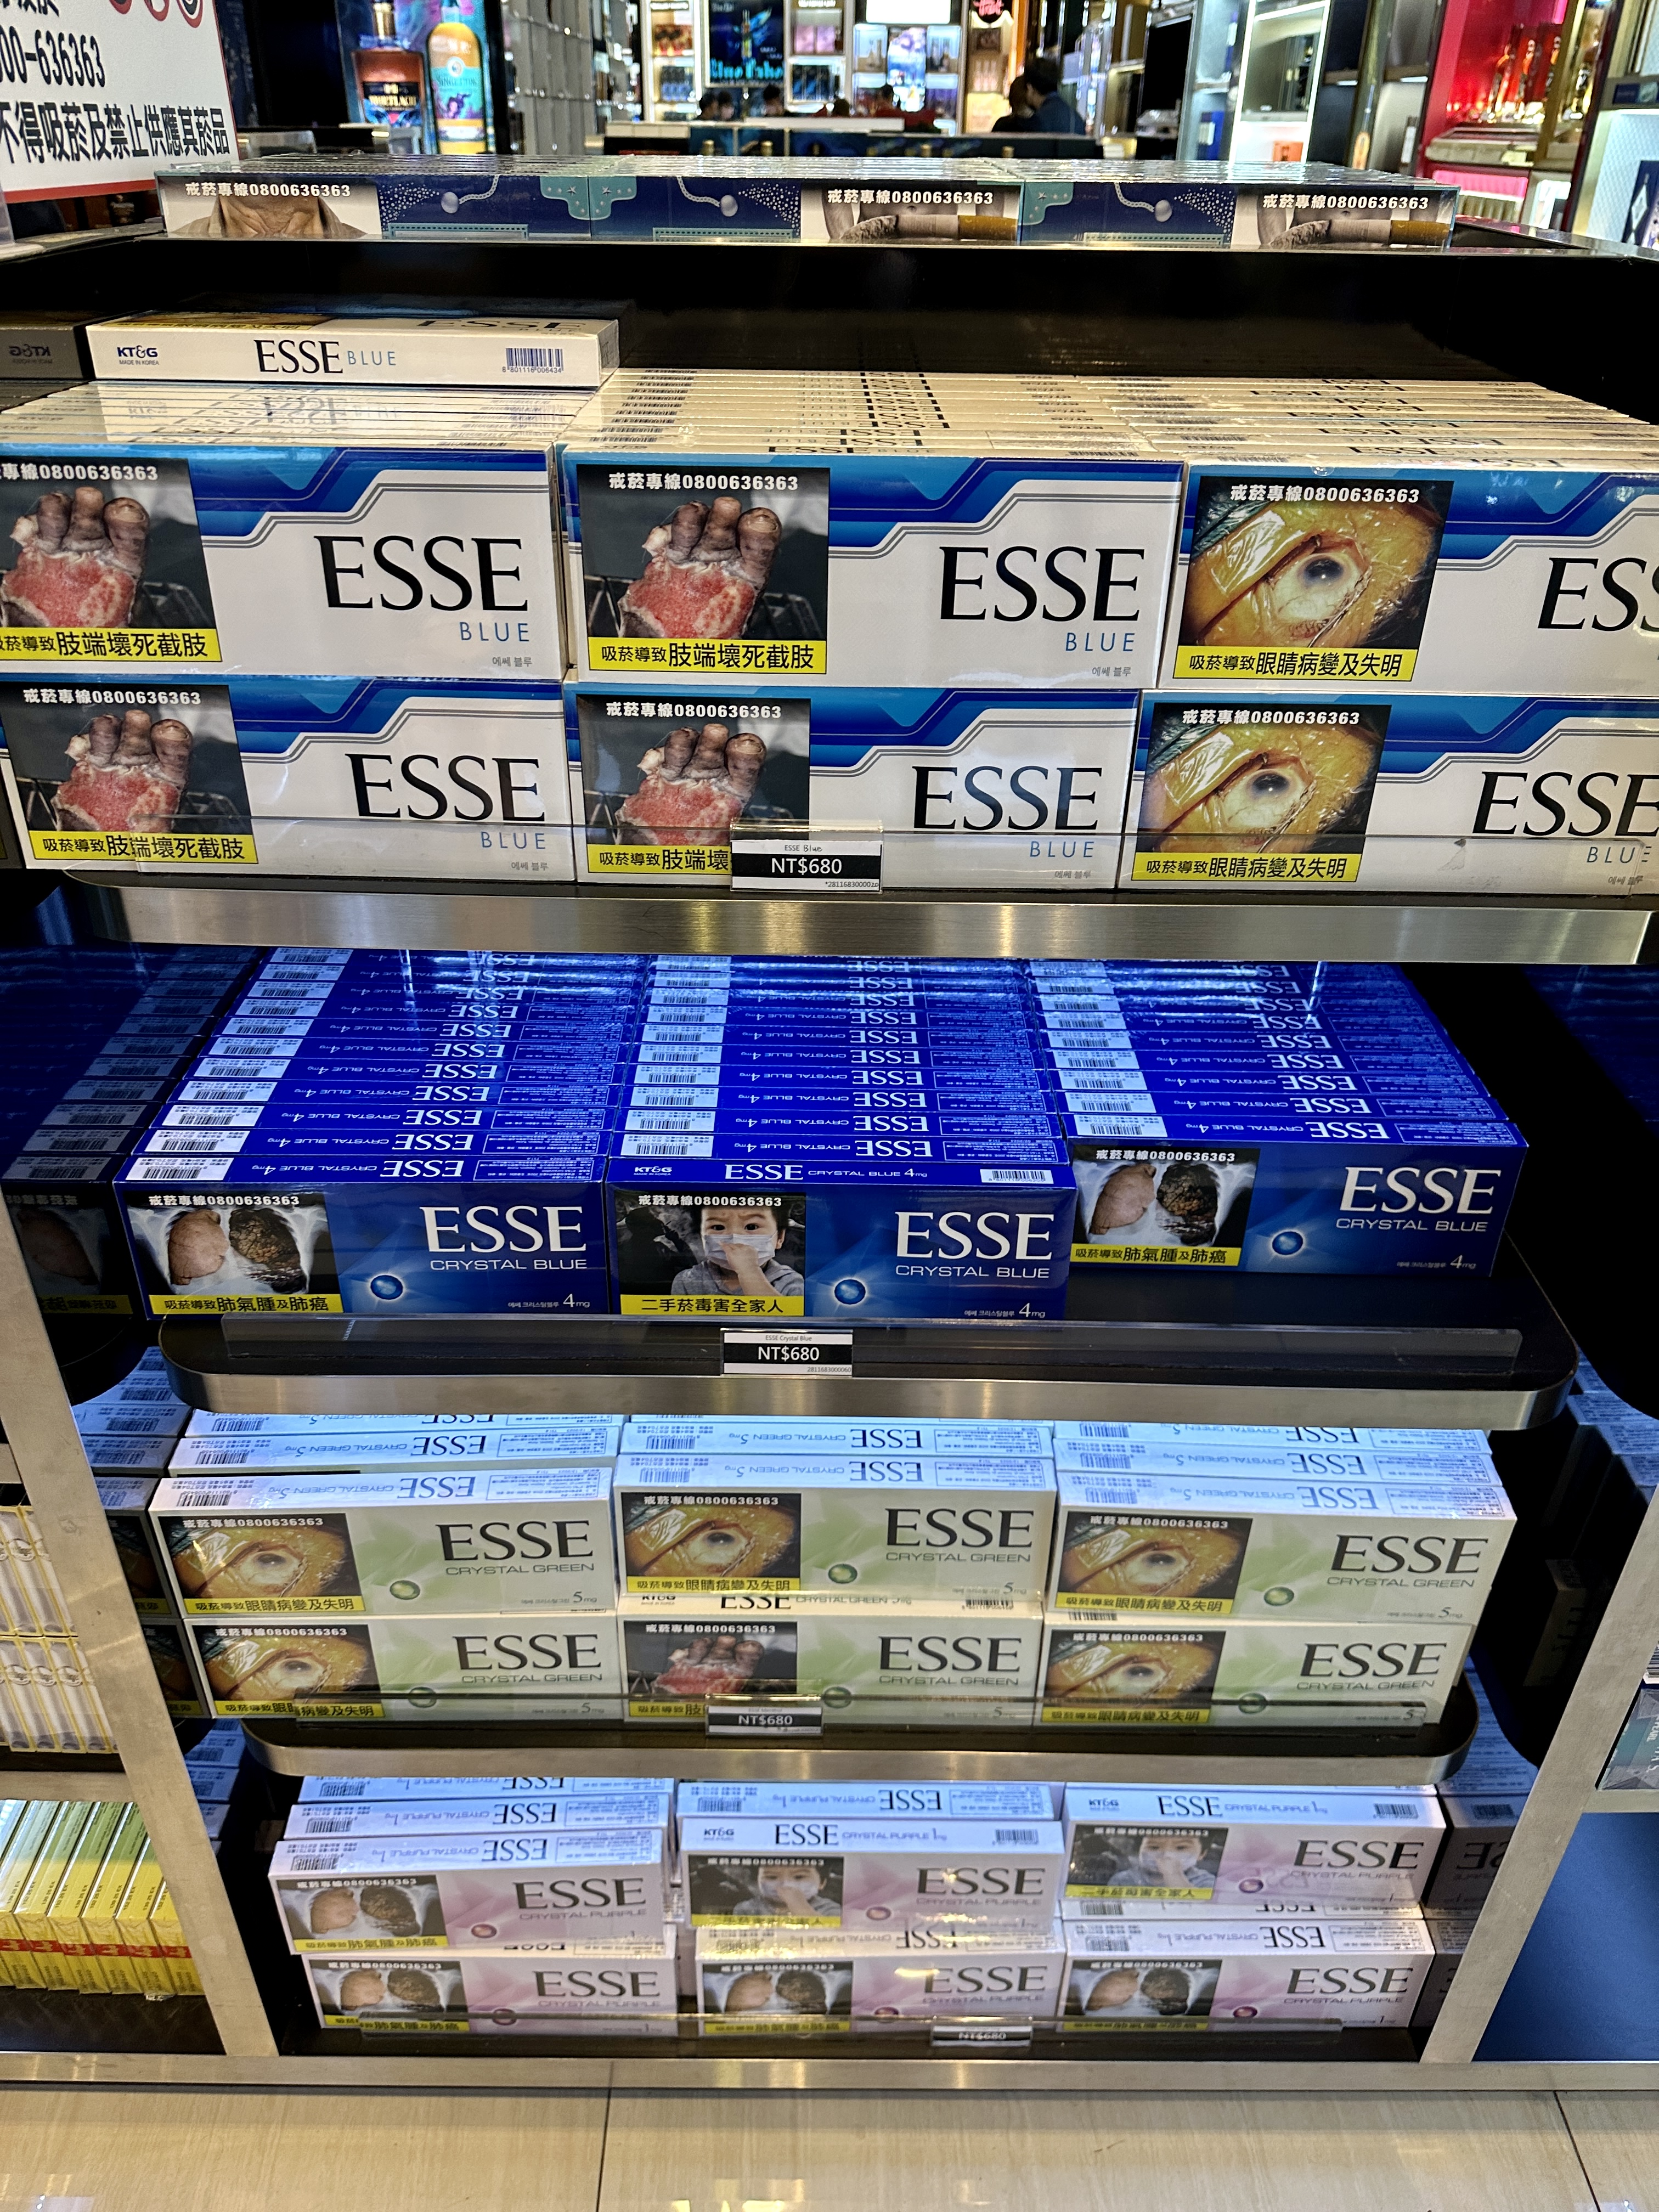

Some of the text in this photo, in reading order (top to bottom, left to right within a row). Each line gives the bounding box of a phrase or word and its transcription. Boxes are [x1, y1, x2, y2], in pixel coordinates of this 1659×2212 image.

[0, 25, 105, 87] 00-636363
[185, 182, 351, 198] 戒菸專線0800636363
[828, 189, 994, 205] 戒菸專線0800636363
[1263, 194, 1429, 210] 戒菸專線0800636363
[117, 339, 397, 374] KT&G ESSE BLUE
[0, 464, 158, 481] 專線0800636363
[609, 472, 799, 491] 戒菸專線0800636363
[1231, 484, 1419, 504] 戒菸專線0800636363
[314, 535, 528, 611] ESSE
[939, 546, 1145, 622] ESSE
[460, 622, 529, 642] BLUE
[1065, 633, 1135, 651] BLUE
[601, 642, 815, 669] 吸菸導致肢端壞死截肢
[1189, 651, 1402, 677] 吸菸導致眼睛病變及失明
[24, 689, 201, 706] 戒菸專線0800636363
[606, 702, 782, 719] 戒菸專線0800636363
[1182, 709, 1360, 725] 戒菸專線0800636363
[345, 753, 545, 822] ESSE
[912, 765, 1102, 831] ESSE
[1472, 771, 1659, 837] ESSE
[481, 832, 546, 850] BLUE
[1030, 841, 1094, 858] BLUE
[771, 857, 842, 876] NT$680
[1147, 856, 1347, 879] 吸菸導致眼睛病變及失明
[1289, 1098, 1372, 1114] ESSE
[853, 1116, 929, 1132] ESSE
[1305, 1121, 1390, 1139] ESSE
[392, 1135, 474, 1151] ESSE
[855, 1139, 933, 1157] ESSE
[1096, 1149, 1235, 1162] 戒菸專線0800636363
[380, 1160, 464, 1177] ESSE
[725, 1164, 804, 1180] ESSE
[1340, 1166, 1501, 1215] ESSE
[149, 1195, 300, 1206] 戒菸專線0800636363
[639, 1195, 782, 1206] 戒菸專線0800636363
[419, 1205, 586, 1252] ESSE
[1336, 1218, 1488, 1232] CRYSTAL BLUE
[895, 1211, 1054, 1260] ESSE
[431, 1259, 588, 1271] CRYSTAL BLUE
[895, 1265, 1050, 1278] CRYSTAL BLUE
[641, 1298, 784, 1314] 二手菸毒害全家人
[758, 1345, 820, 1362] NT$680
[849, 1462, 924, 1482] ESSE
[885, 1508, 1034, 1548] ESSE
[435, 1520, 593, 1561] ESSE
[886, 1552, 1031, 1562] CRYSTAL GREEN
[1331, 1534, 1488, 1573] ESSE
[446, 1563, 594, 1576] CRYSTAL GREEN
[1327, 1577, 1475, 1588] CRYSTAL GREEN
[452, 1634, 601, 1670] ESSE
[878, 1636, 1022, 1672] ESSE
[1300, 1643, 1447, 1678] ESSE
[462, 1673, 602, 1683] CRYSTAL GREEN
[879, 1675, 1019, 1685] CRYSTAL GREEN
[738, 1715, 793, 1726] NT$680
[1156, 1795, 1223, 1818] ESSE
[775, 1824, 839, 1846] ESSE
[1293, 1839, 1424, 1870] ESSE
[917, 1867, 1046, 1895] ESSE
[512, 1877, 646, 1909] ESSE
[532, 1970, 661, 1997] ESSE
[924, 1966, 1048, 1994] ESSE
[1286, 1967, 1414, 1994] ESSE
